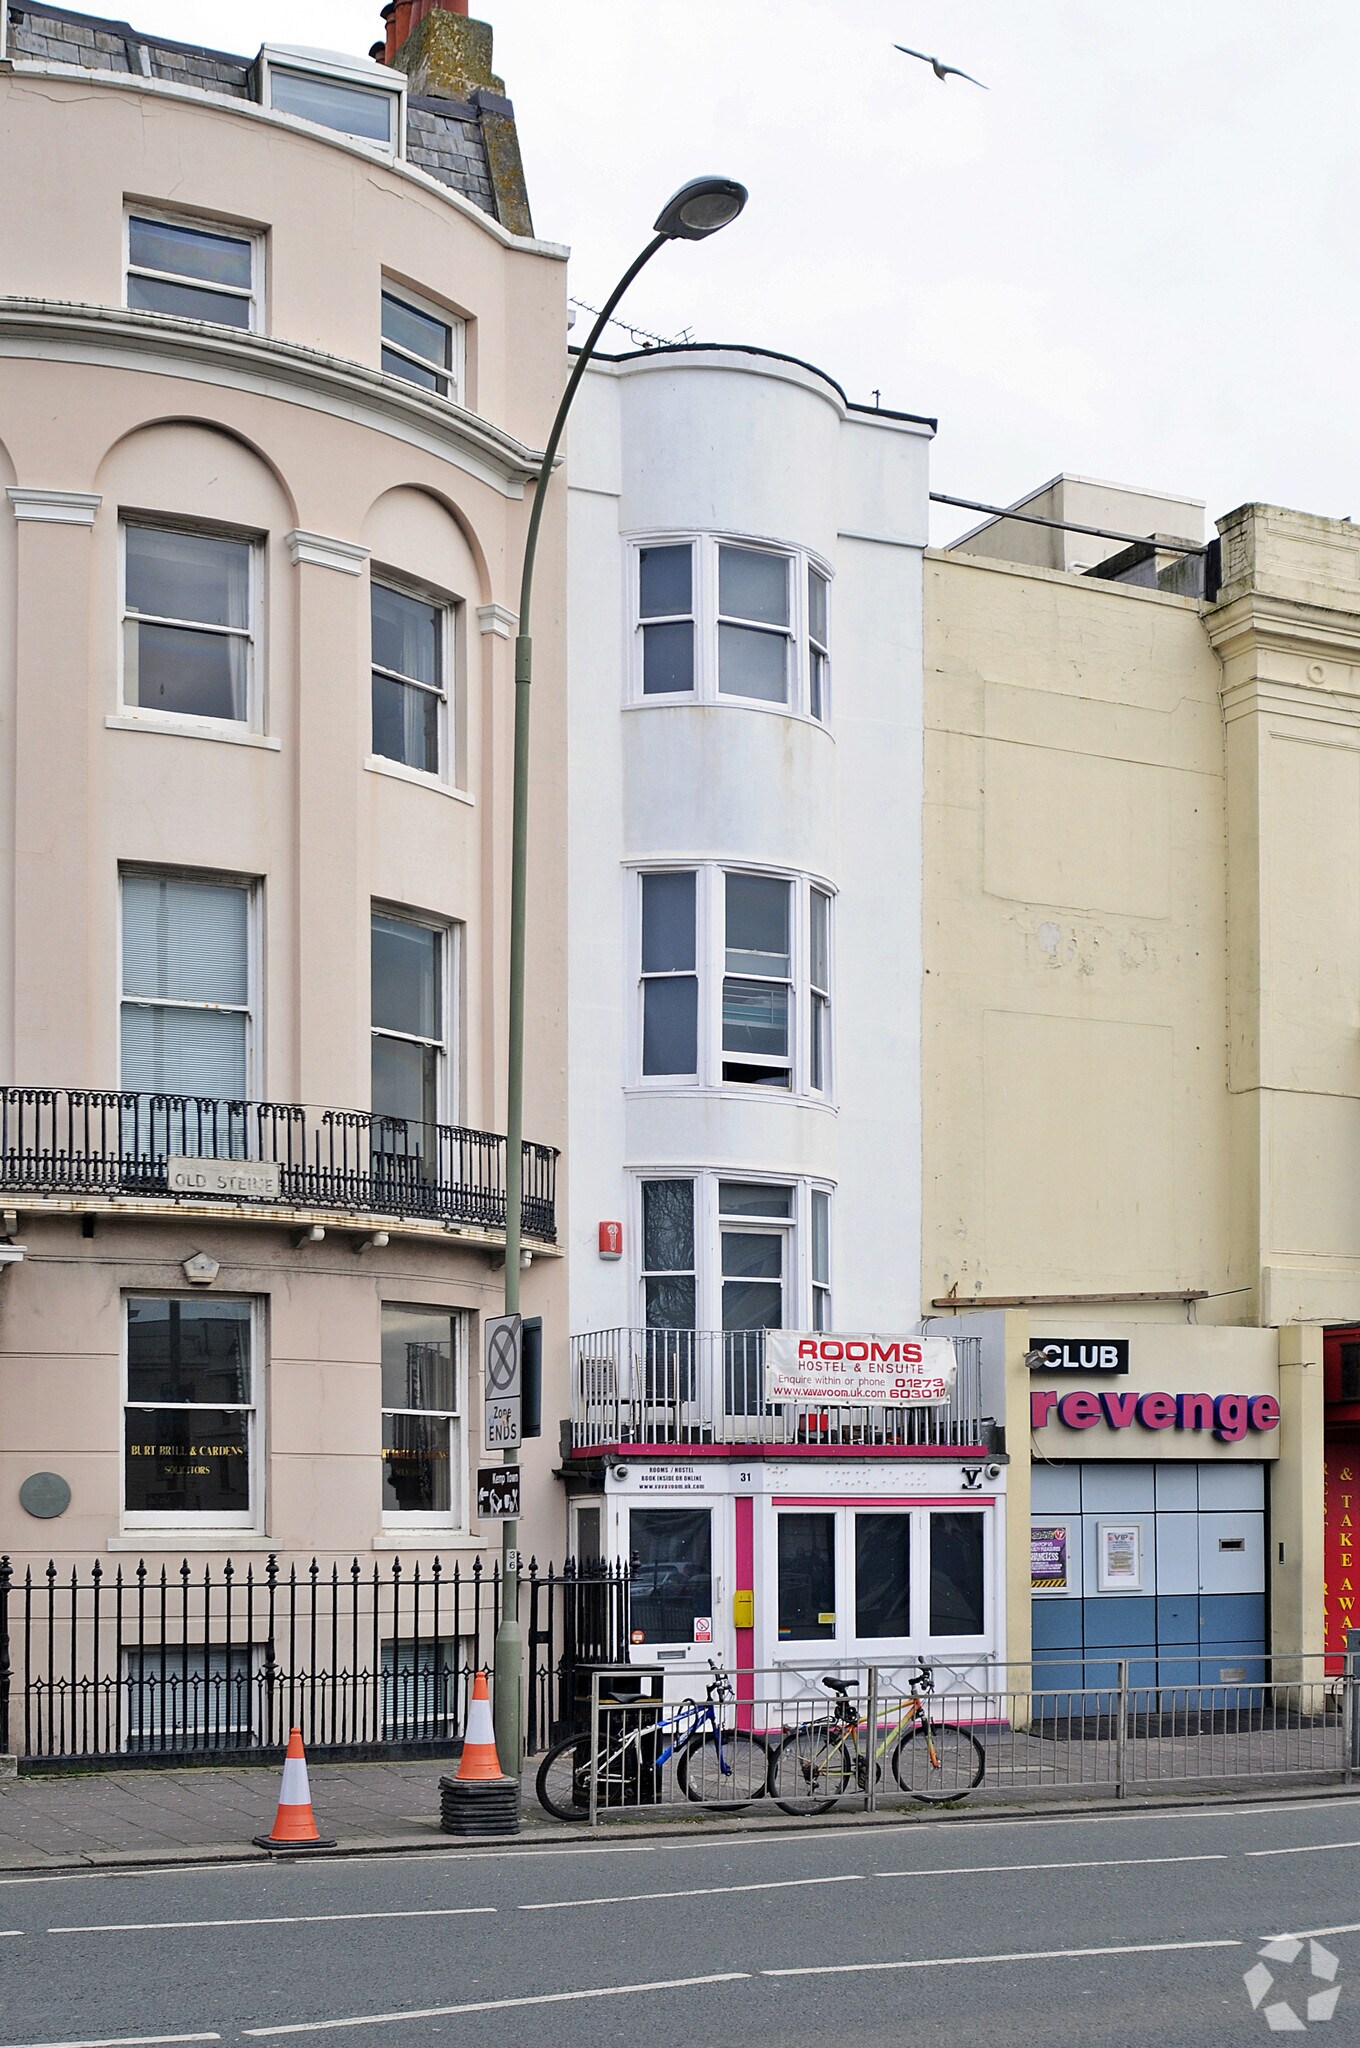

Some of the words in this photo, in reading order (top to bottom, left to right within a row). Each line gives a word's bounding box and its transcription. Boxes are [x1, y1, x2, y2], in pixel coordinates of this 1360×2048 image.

[175, 1173, 206, 1187] OLD
[798, 1339, 922, 1363] ROOMS
[1043, 1344, 1118, 1369] CLUB
[798, 1360, 847, 1372] HOSTEL
[853, 1362, 861, 1373] &
[868, 1363, 924, 1374] ENSUITE
[778, 1374, 812, 1385] Enquire
[815, 1375, 841, 1385] within
[844, 1378, 854, 1386] or
[858, 1377, 886, 1387] phone
[895, 1378, 944, 1388] 01273
[889, 1388, 946, 1399] 603010
[493, 1406, 512, 1420] Zone
[1030, 1390, 1280, 1442] revenge
[489, 1423, 517, 1442] ENDS
[131, 1445, 157, 1456] BURT
[159, 1445, 187, 1456] BRILL
[189, 1445, 197, 1456] &
[199, 1445, 244, 1456] CARDENS
[492, 1472, 506, 1487] Kemp
[506, 1471, 519, 1483] Town
[740, 1473, 751, 1482] 31
[962, 1467, 983, 1490] V
[1340, 1467, 1353, 1481] &
[1340, 1494, 1353, 1567] TAKE
